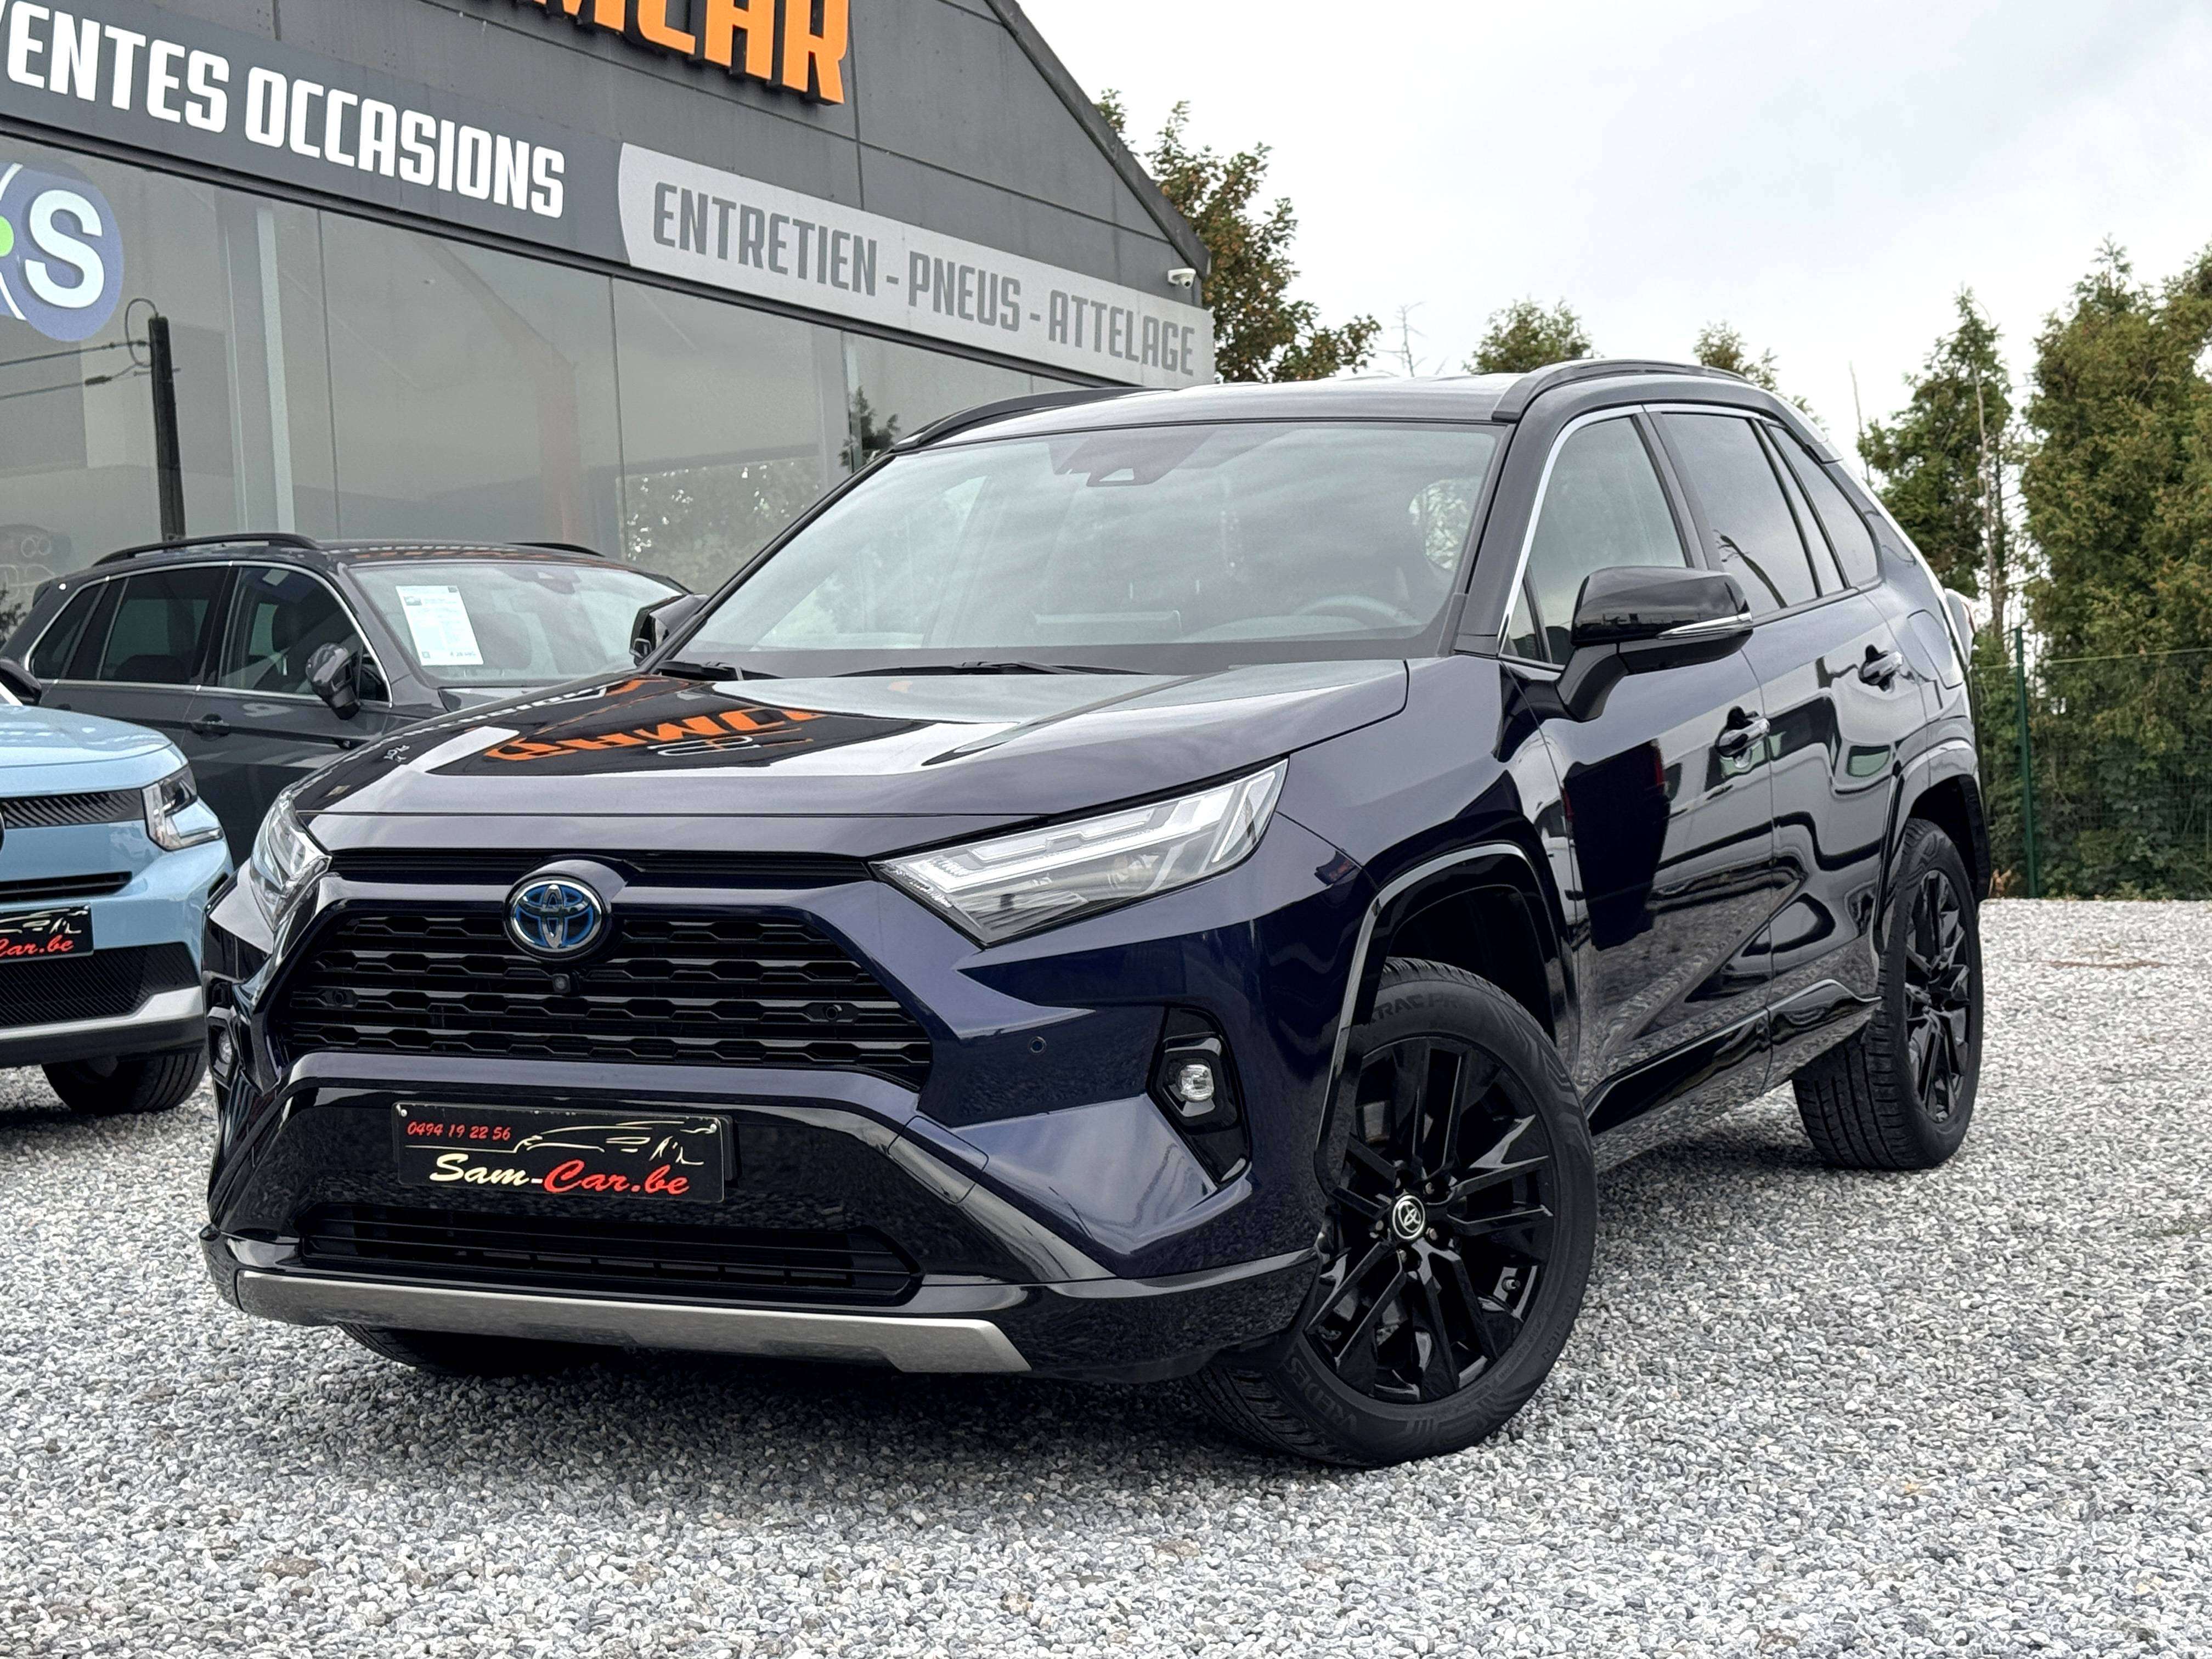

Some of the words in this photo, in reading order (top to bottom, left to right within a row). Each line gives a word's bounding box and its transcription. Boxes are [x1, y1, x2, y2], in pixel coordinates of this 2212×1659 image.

[0, 0, 229, 133] ENTES
[245, 66, 565, 218] OCCASIONS
[653, 182, 877, 296] ENTRETIEN
[909, 251, 1021, 332] PNEUS
[1049, 289, 1195, 376] ATTELAGE
[407, 1121, 443, 1137] 0494
[448, 1124, 465, 1138] 19
[469, 1126, 489, 1139] 22
[493, 1126, 511, 1141] 56
[430, 1153, 689, 1195] Sam-Car.be
